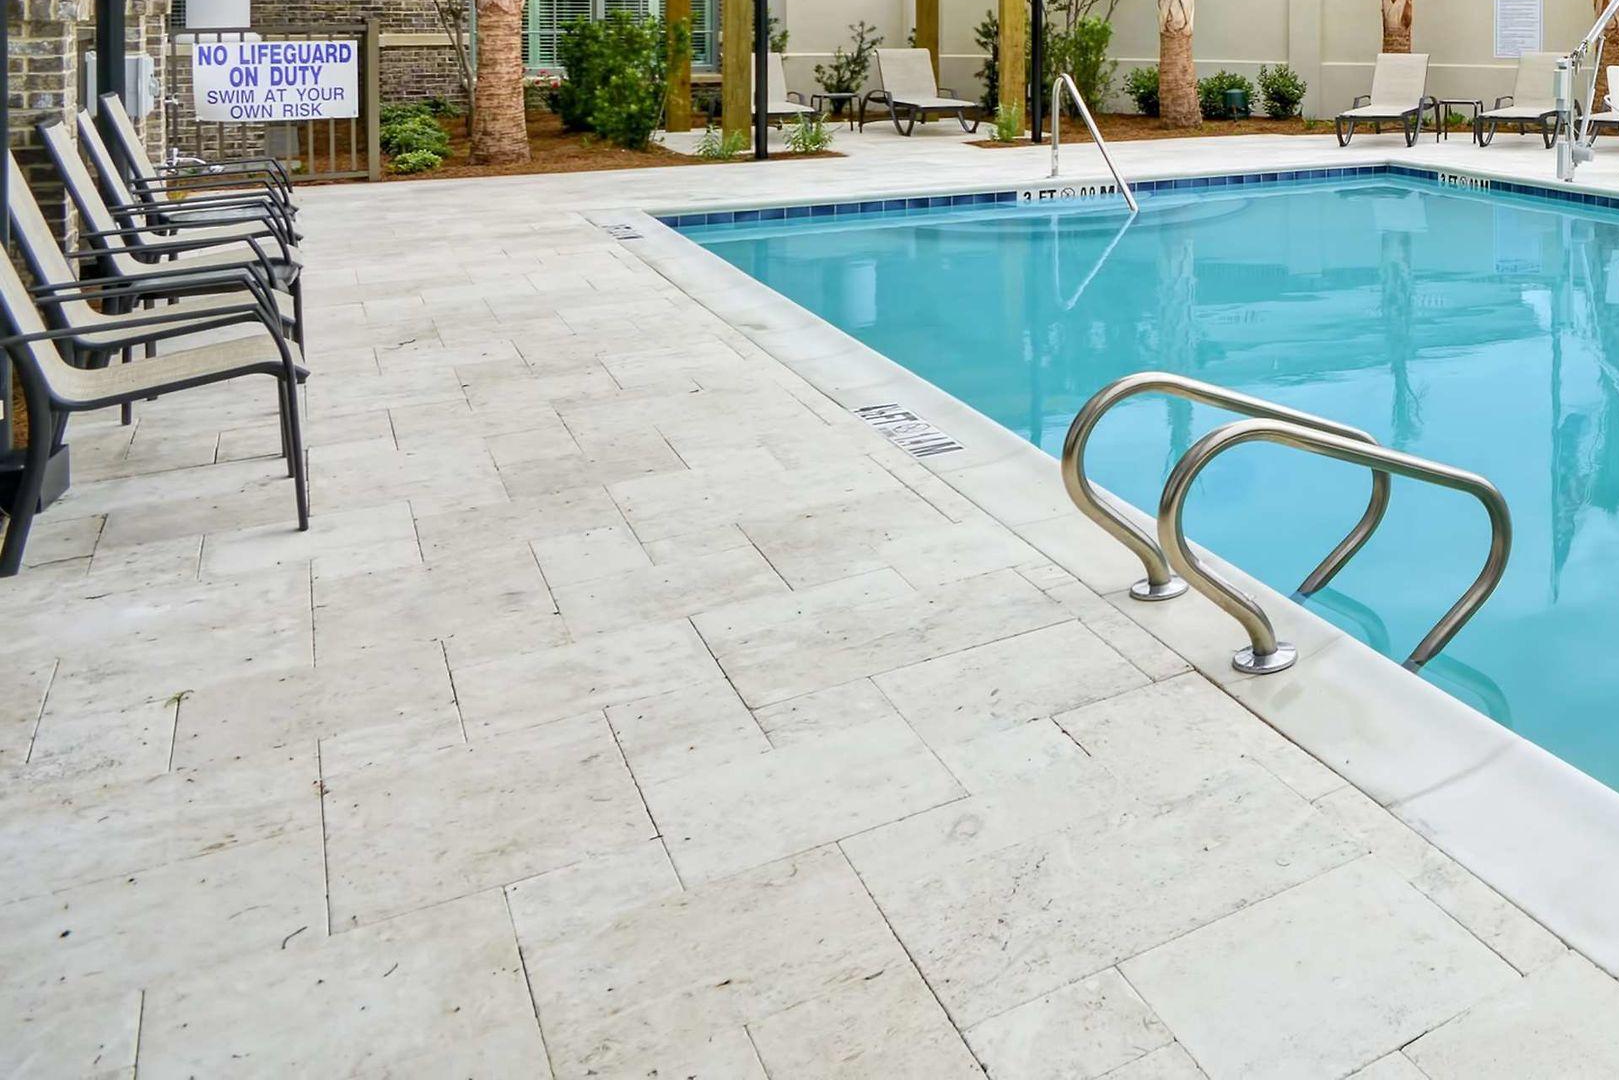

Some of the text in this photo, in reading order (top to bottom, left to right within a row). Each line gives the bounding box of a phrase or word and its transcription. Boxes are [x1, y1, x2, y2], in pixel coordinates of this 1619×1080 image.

[198, 43, 352, 65] NO LIFEGUARD
[229, 65, 322, 87] ON DUTY
[207, 87, 345, 104] SWIM AT YOUR
[230, 102, 322, 119] OWN RISK
[1039, 189, 1057, 201] FT
[865, 411, 919, 426] FT
[909, 441, 964, 457] M
